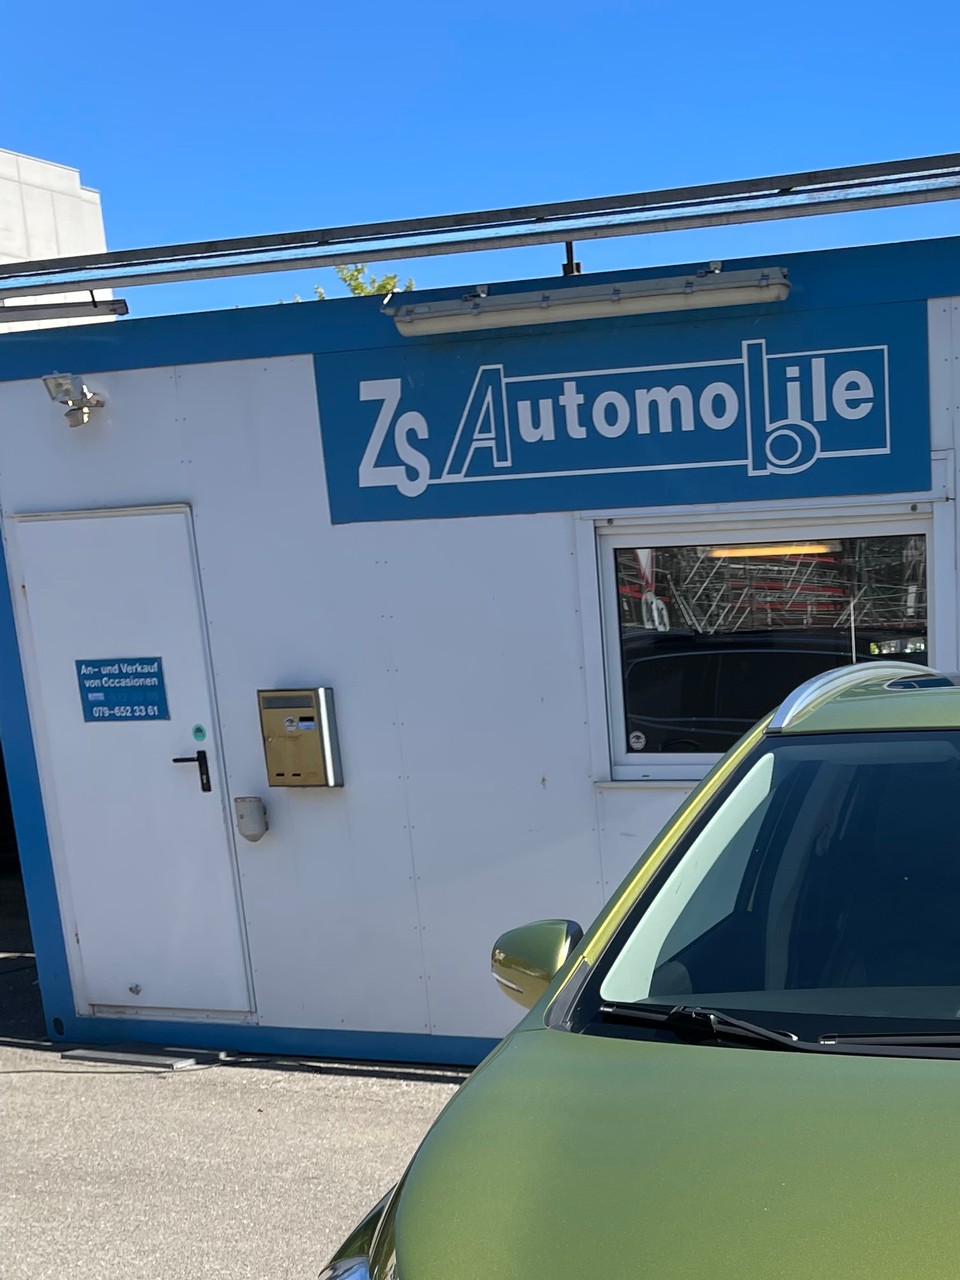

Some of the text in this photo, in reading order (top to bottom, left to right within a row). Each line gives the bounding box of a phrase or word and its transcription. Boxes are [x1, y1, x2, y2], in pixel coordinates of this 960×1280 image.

[441, 338, 875, 478] Automobile
[80, 662, 158, 675] An- und Verkauf
[84, 676, 158, 688] von Occasionen
[133, 705, 146, 716] 33
[147, 705, 158, 716] 61
